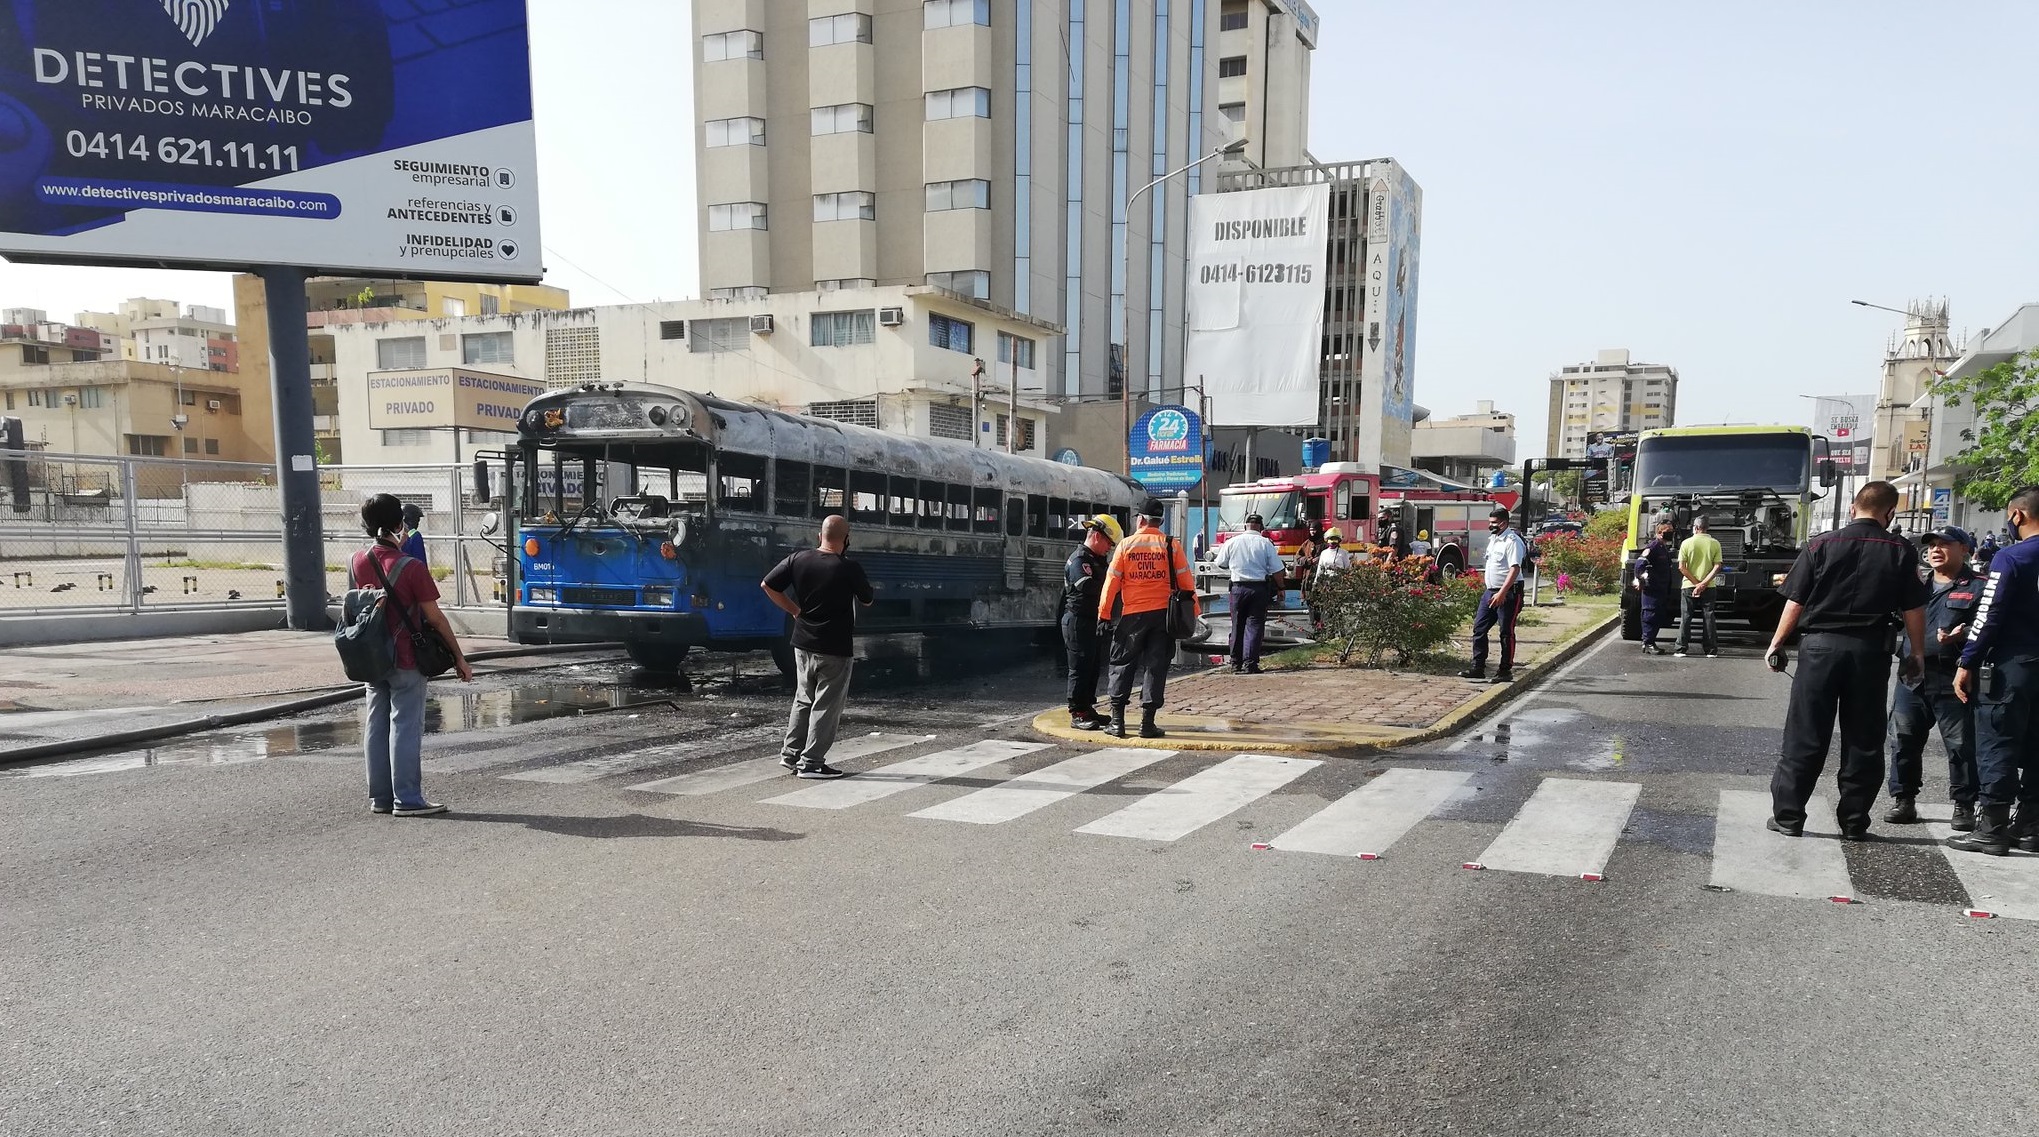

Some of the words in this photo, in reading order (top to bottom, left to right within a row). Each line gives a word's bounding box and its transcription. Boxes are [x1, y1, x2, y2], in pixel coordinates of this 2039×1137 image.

[33, 47, 353, 108] DETECTIVES
[82, 93, 184, 116] PRIVADOS
[191, 102, 312, 125] MARACAIBO
[66, 130, 149, 161] 0414
[158, 136, 298, 171] 621.11.11
[394, 160, 490, 177] SEGUIMIENTO
[412, 173, 490, 187] empresarial
[43, 184, 327, 211] www.detectivesprivadosmaracaibo.com
[408, 197, 481, 212] referencias
[484, 204, 492, 215] y
[387, 208, 492, 225] ANTECEDENTES
[1215, 217, 1307, 241] DISPONIBLE
[406, 234, 493, 249] INFIDELIDAD
[399, 246, 407, 257] y
[411, 246, 494, 260] prenupciales
[1200, 263, 1312, 285] 0414-6123115
[370, 374, 450, 389] ESTACIONAMIENTO
[459, 376, 546, 396] ESTACIONAMIENTO
[386, 401, 434, 415] PRIVADO
[1158, 418, 1180, 433] 24
[1149, 440, 1187, 451] FARMACIA
[1137, 561, 1156, 570] CIVIL
[1967, 571, 2001, 641] EMERGNCIA
